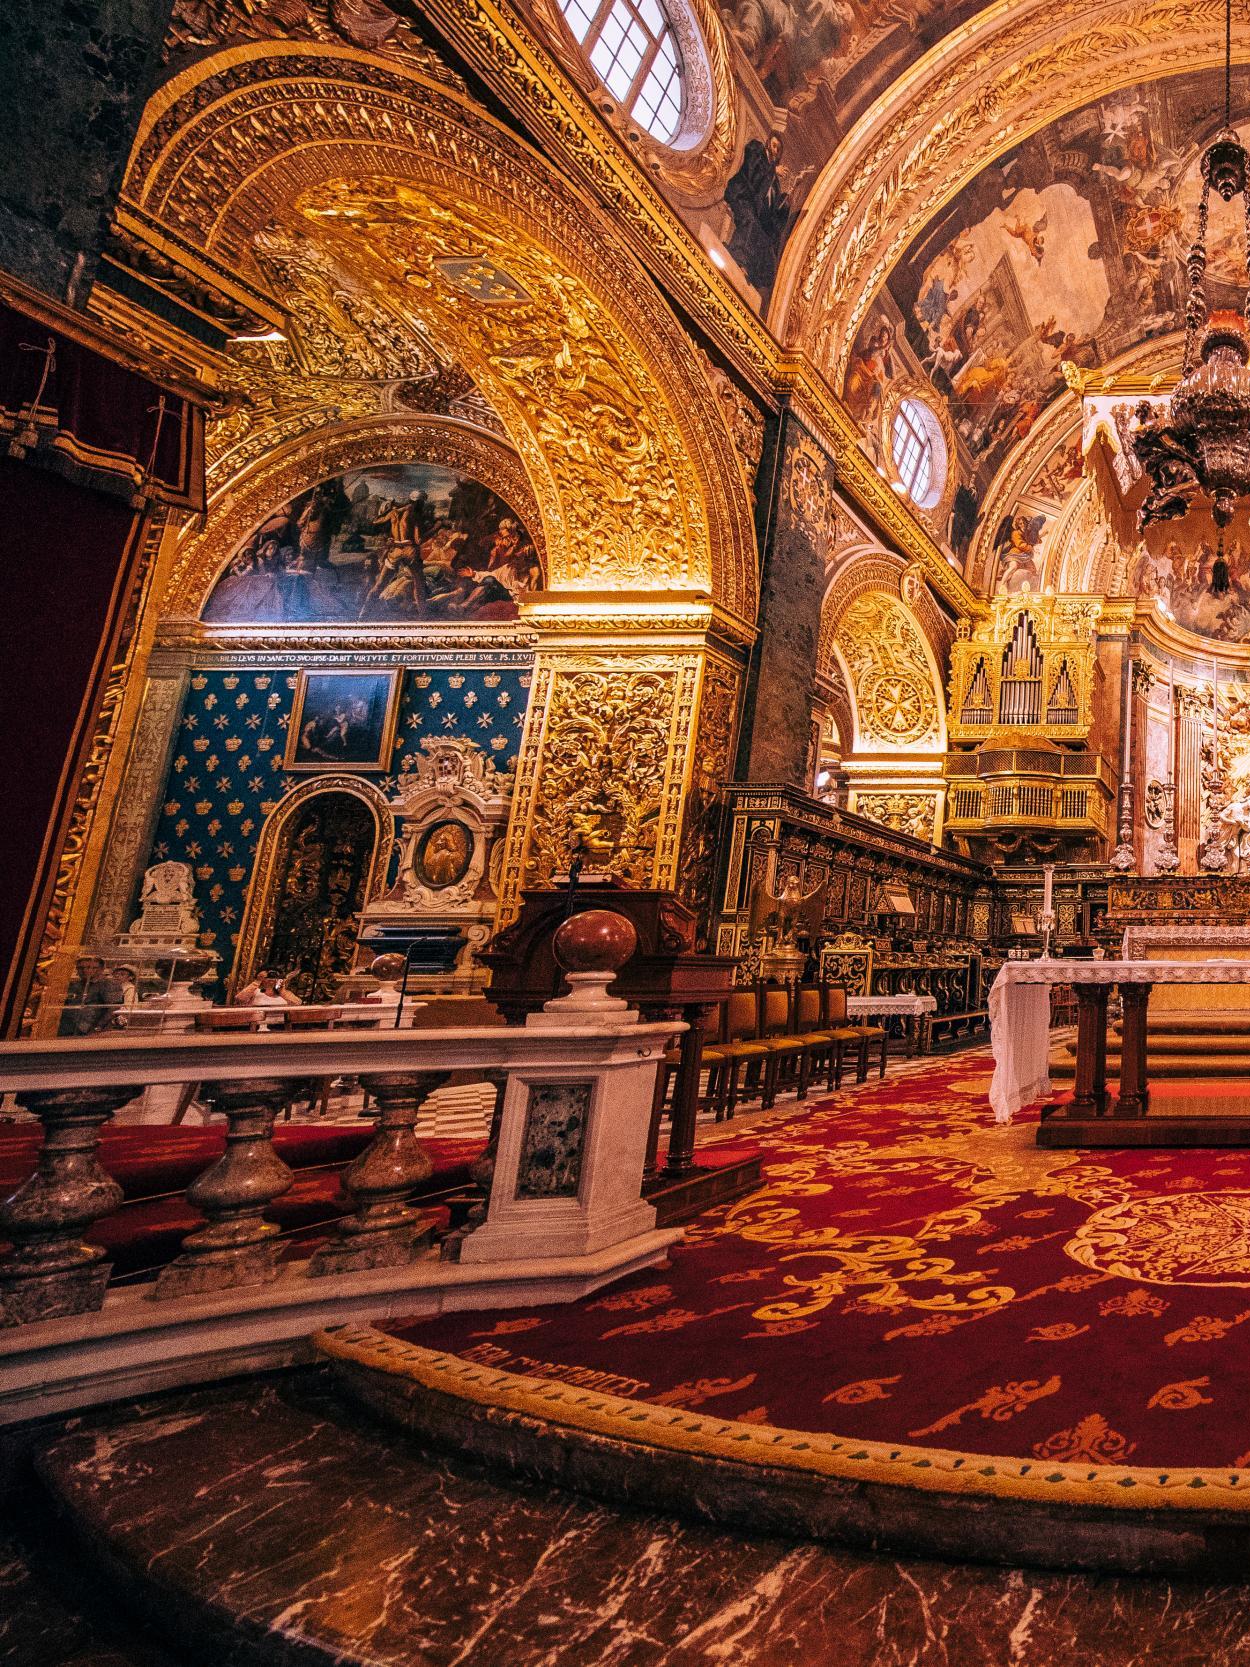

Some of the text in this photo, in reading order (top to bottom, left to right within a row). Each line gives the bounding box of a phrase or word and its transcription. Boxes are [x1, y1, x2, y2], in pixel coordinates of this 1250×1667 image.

[391, 654, 402, 662] ET
[402, 654, 454, 662] FORTITVDINE
[455, 653, 477, 661] PLEBI
